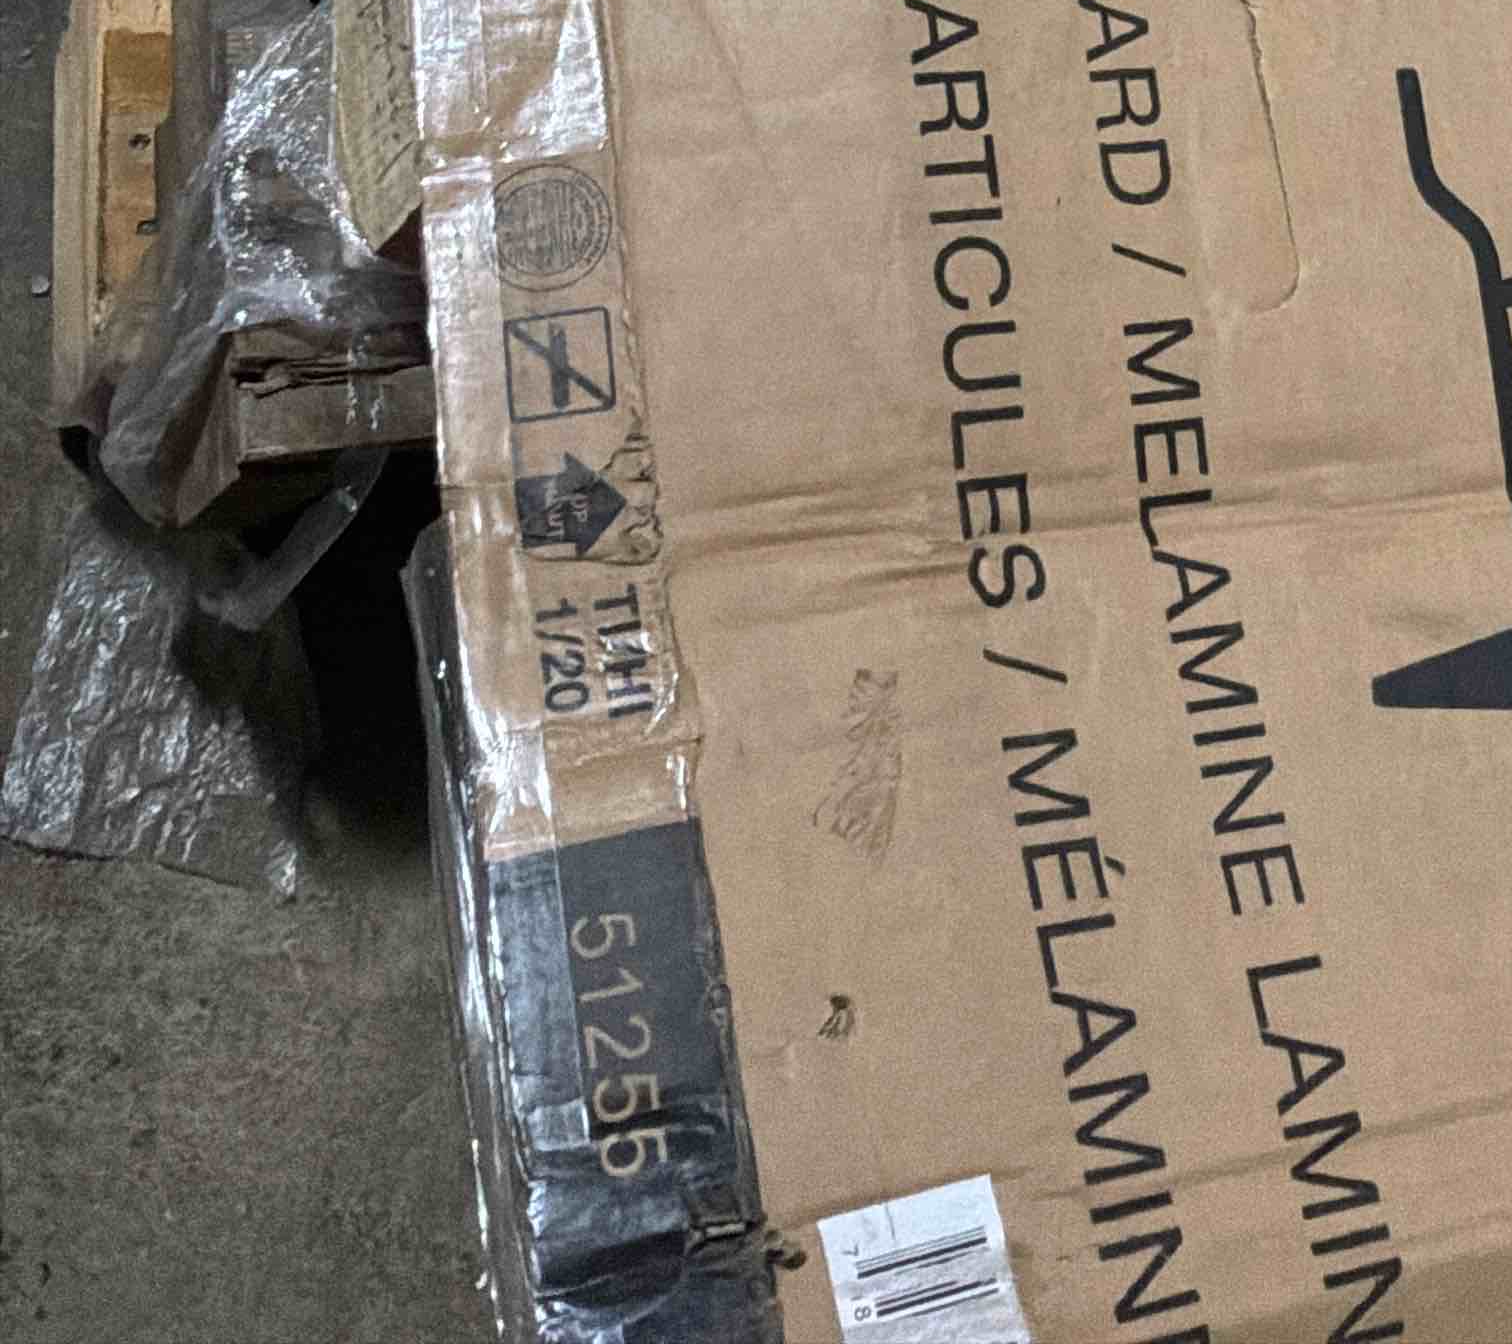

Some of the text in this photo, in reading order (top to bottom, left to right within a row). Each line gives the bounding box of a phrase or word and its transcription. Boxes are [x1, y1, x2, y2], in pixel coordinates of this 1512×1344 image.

[534, 598, 590, 713] 1/20
[1122, 317, 1306, 916] MELAMINE
[570, 912, 668, 1178] 51255
[1002, 728, 1211, 1344] MÉLAMIN
